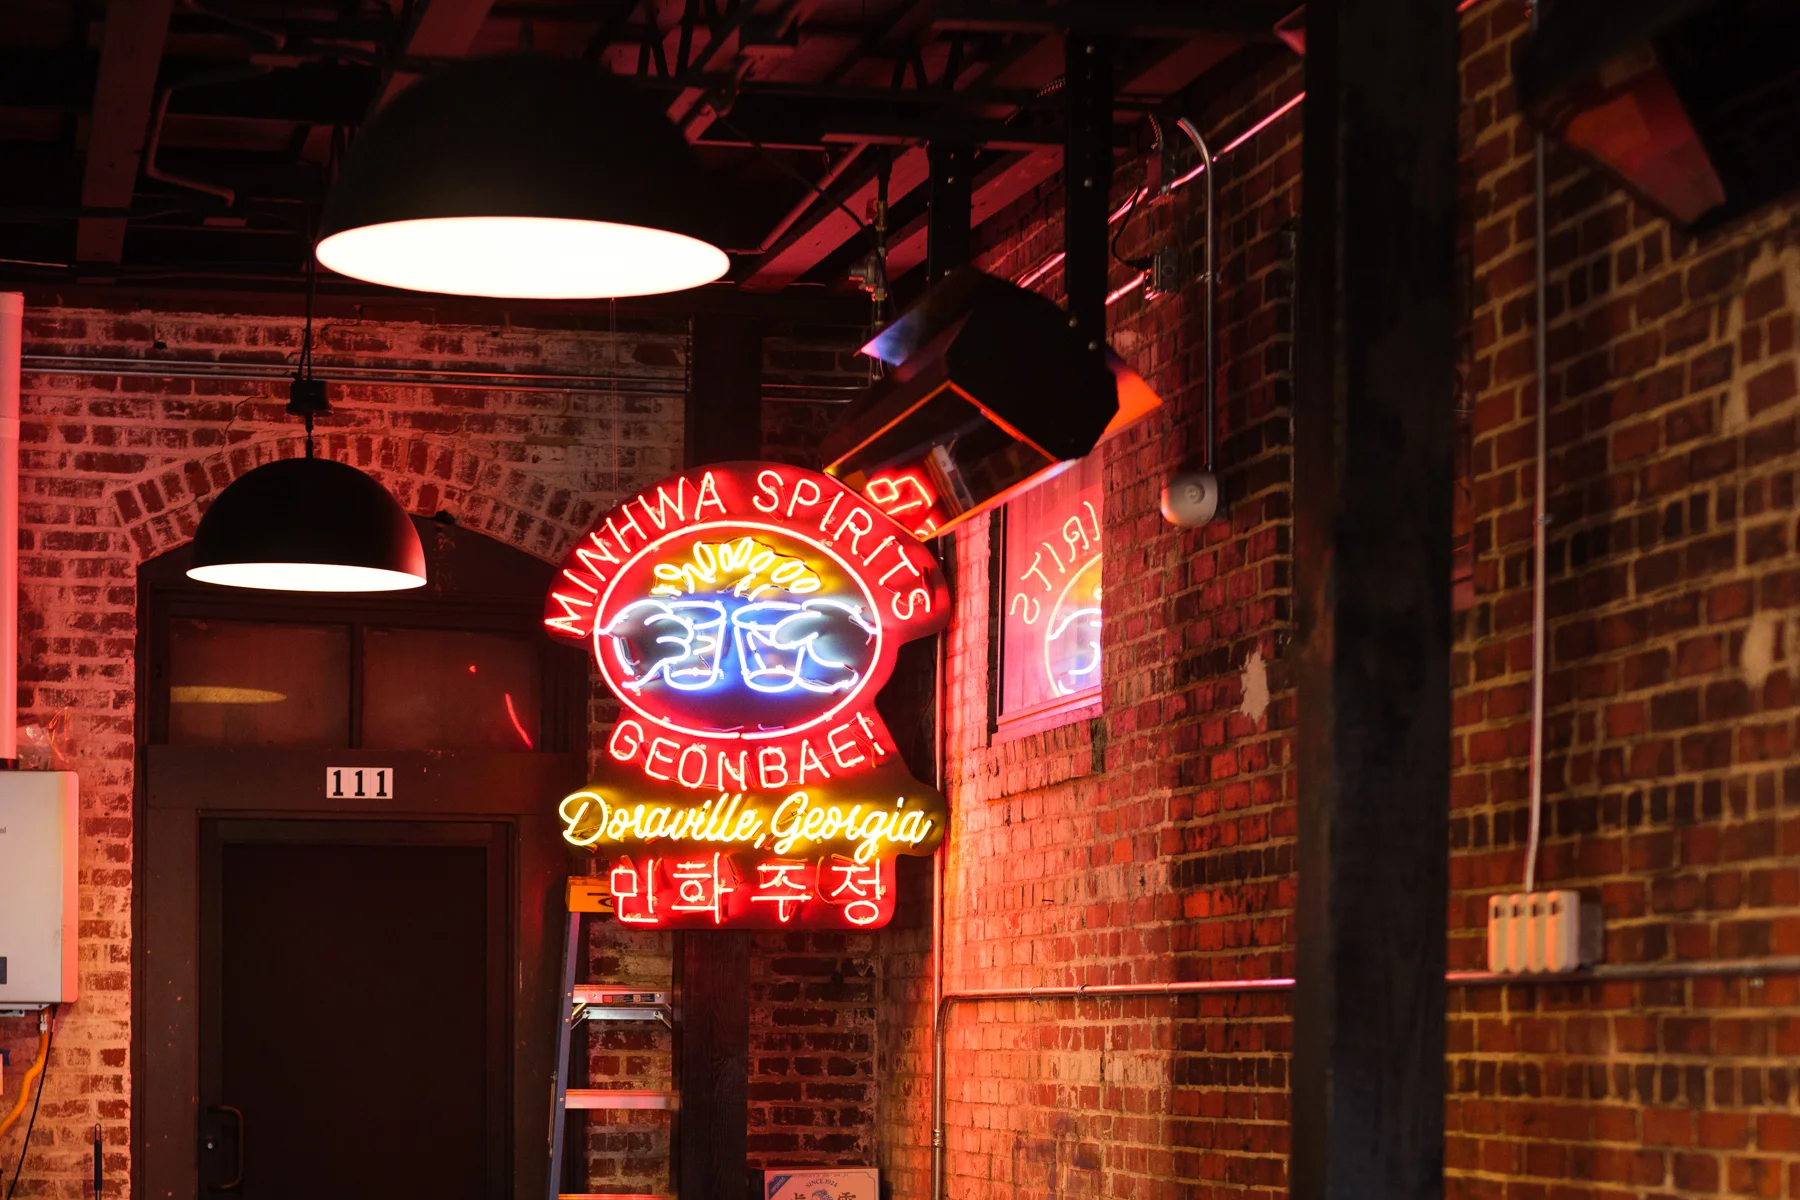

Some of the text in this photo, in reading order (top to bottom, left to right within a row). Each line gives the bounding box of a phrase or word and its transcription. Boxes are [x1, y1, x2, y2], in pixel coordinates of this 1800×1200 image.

[544, 470, 931, 636] MINHWA SPIRITS
[332, 769, 387, 797] 111
[559, 790, 933, 864] Doraville, Georgia
[610, 852, 881, 925] 민화주정
[806, 1179, 838, 1188] SINCE 1924
